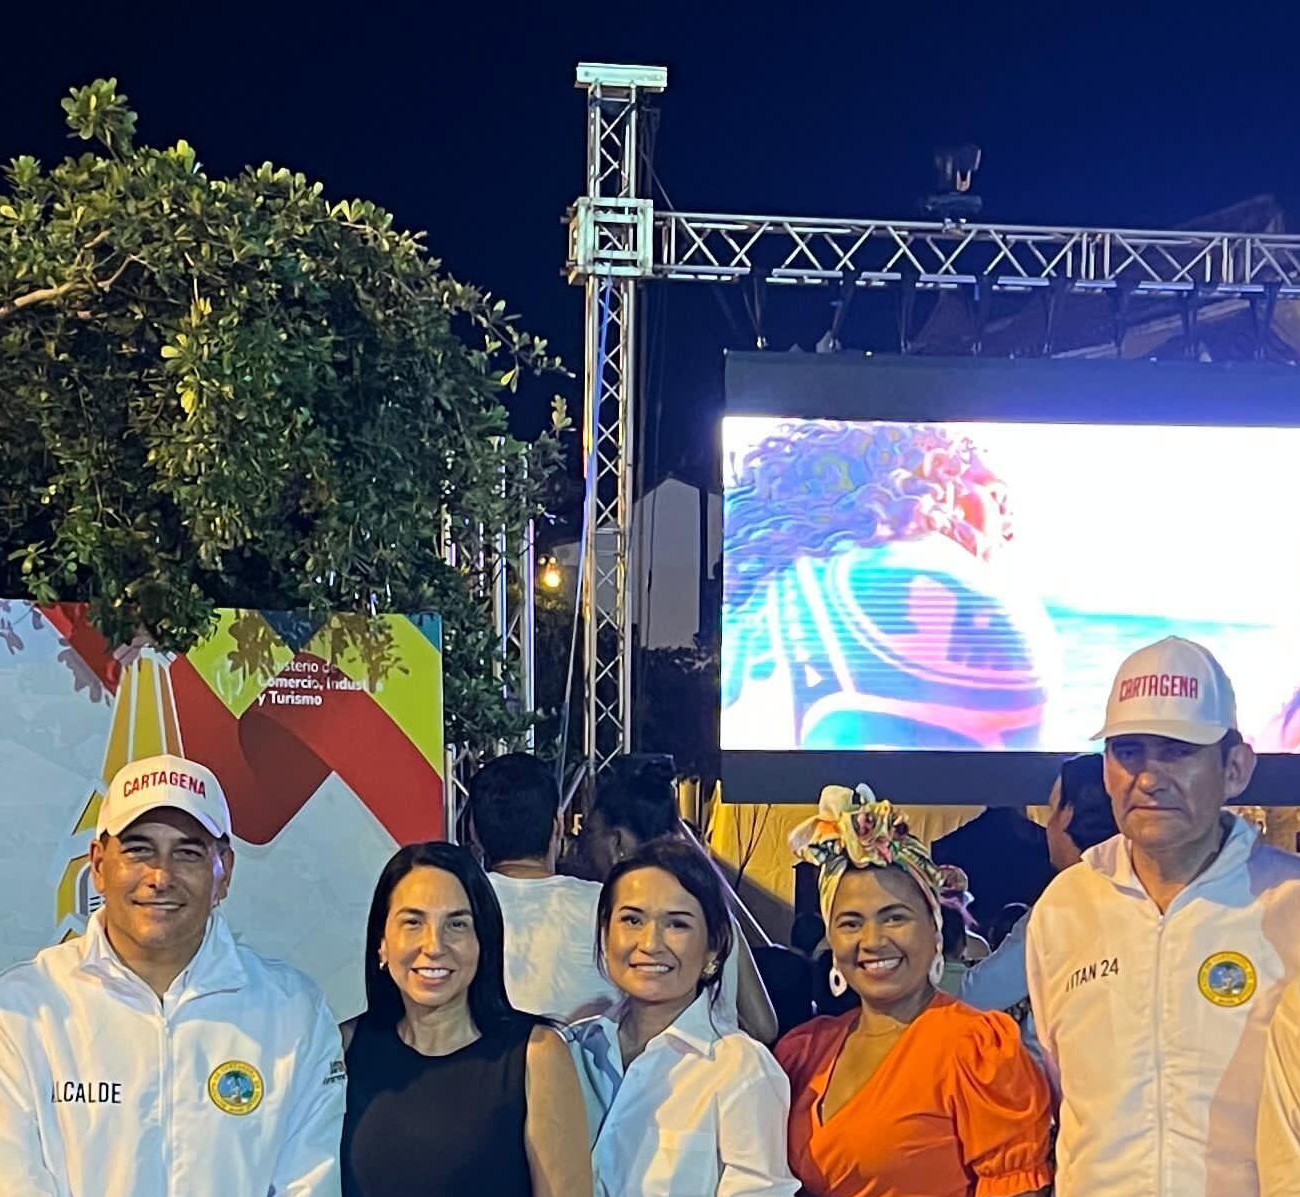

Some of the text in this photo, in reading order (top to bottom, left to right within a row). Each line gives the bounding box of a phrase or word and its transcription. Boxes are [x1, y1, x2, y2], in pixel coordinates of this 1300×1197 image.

[256, 690, 323, 707] y Turismo
[1118, 674, 1199, 702] CARTAGENA
[123, 769, 207, 799] CARTAGENA
[1101, 957, 1120, 978] 24
